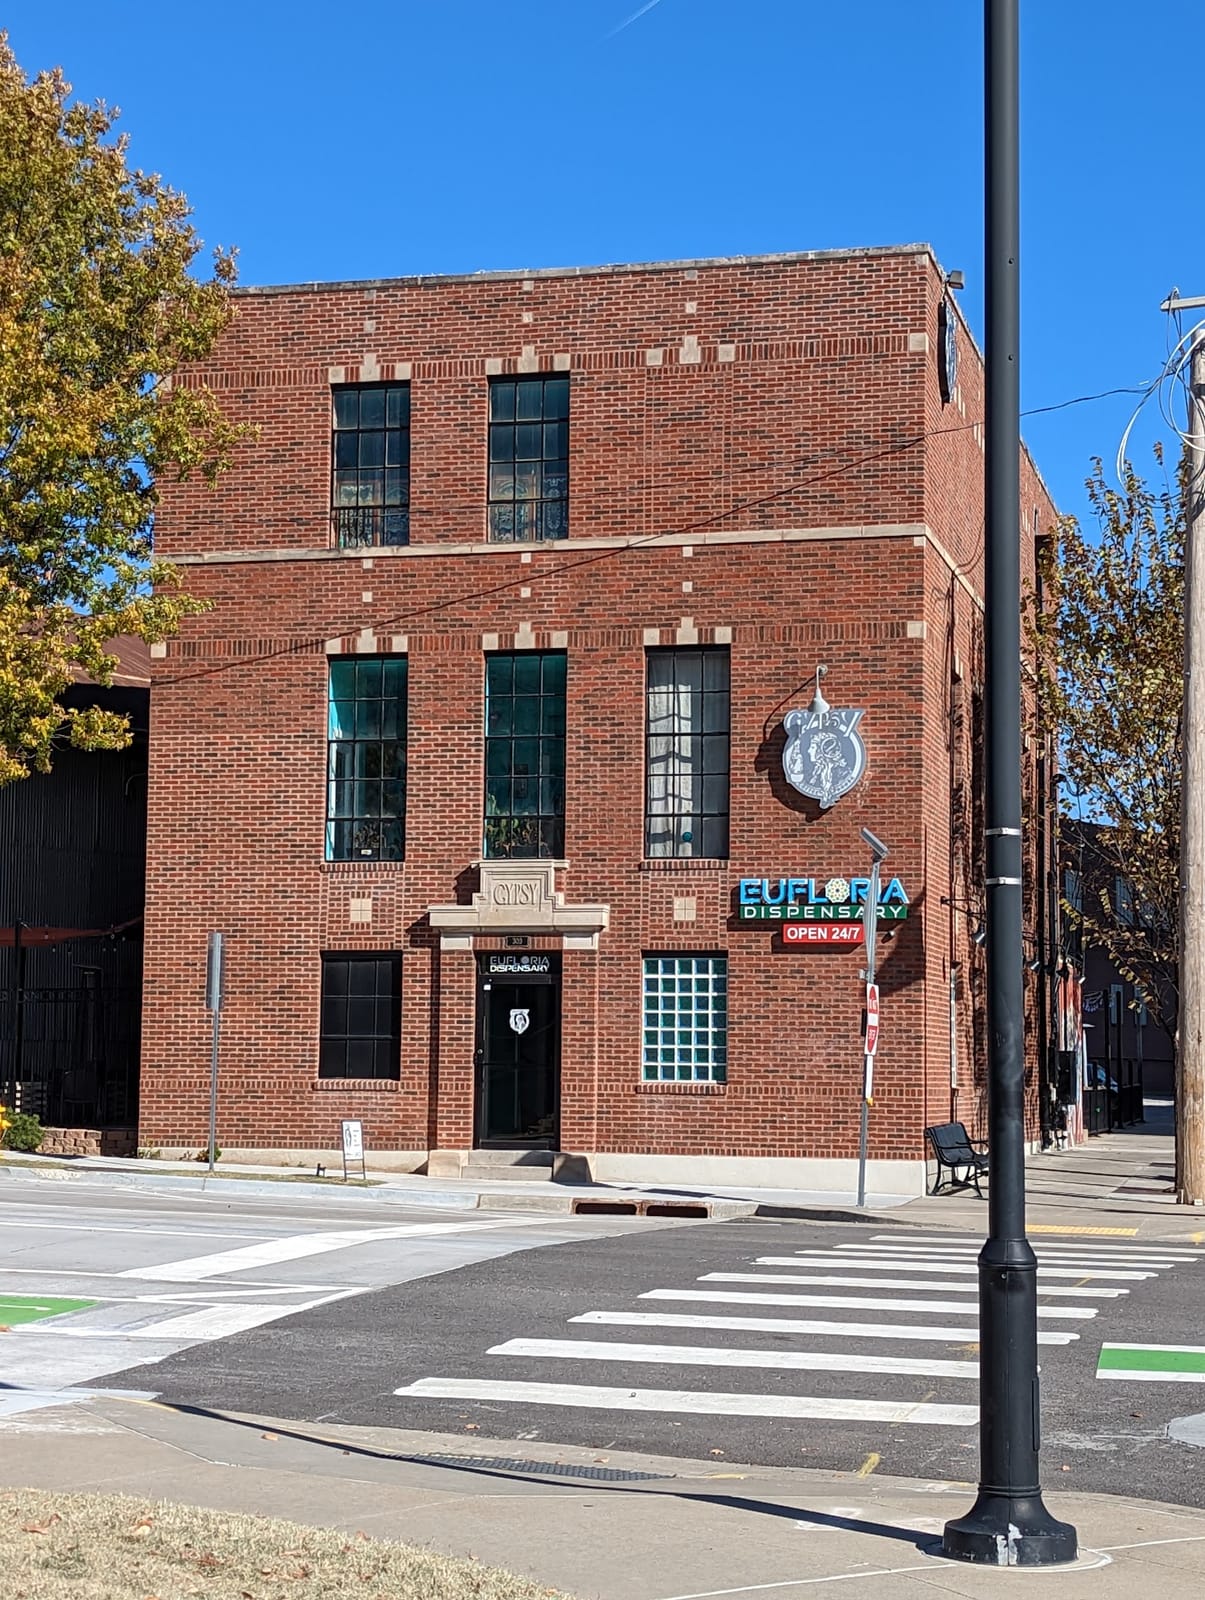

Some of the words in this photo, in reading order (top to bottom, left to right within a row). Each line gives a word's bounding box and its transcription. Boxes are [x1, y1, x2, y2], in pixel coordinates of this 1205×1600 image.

[493, 883, 537, 905] GYPSY
[787, 927, 828, 940] OPEN
[831, 927, 860, 940] 24/7
